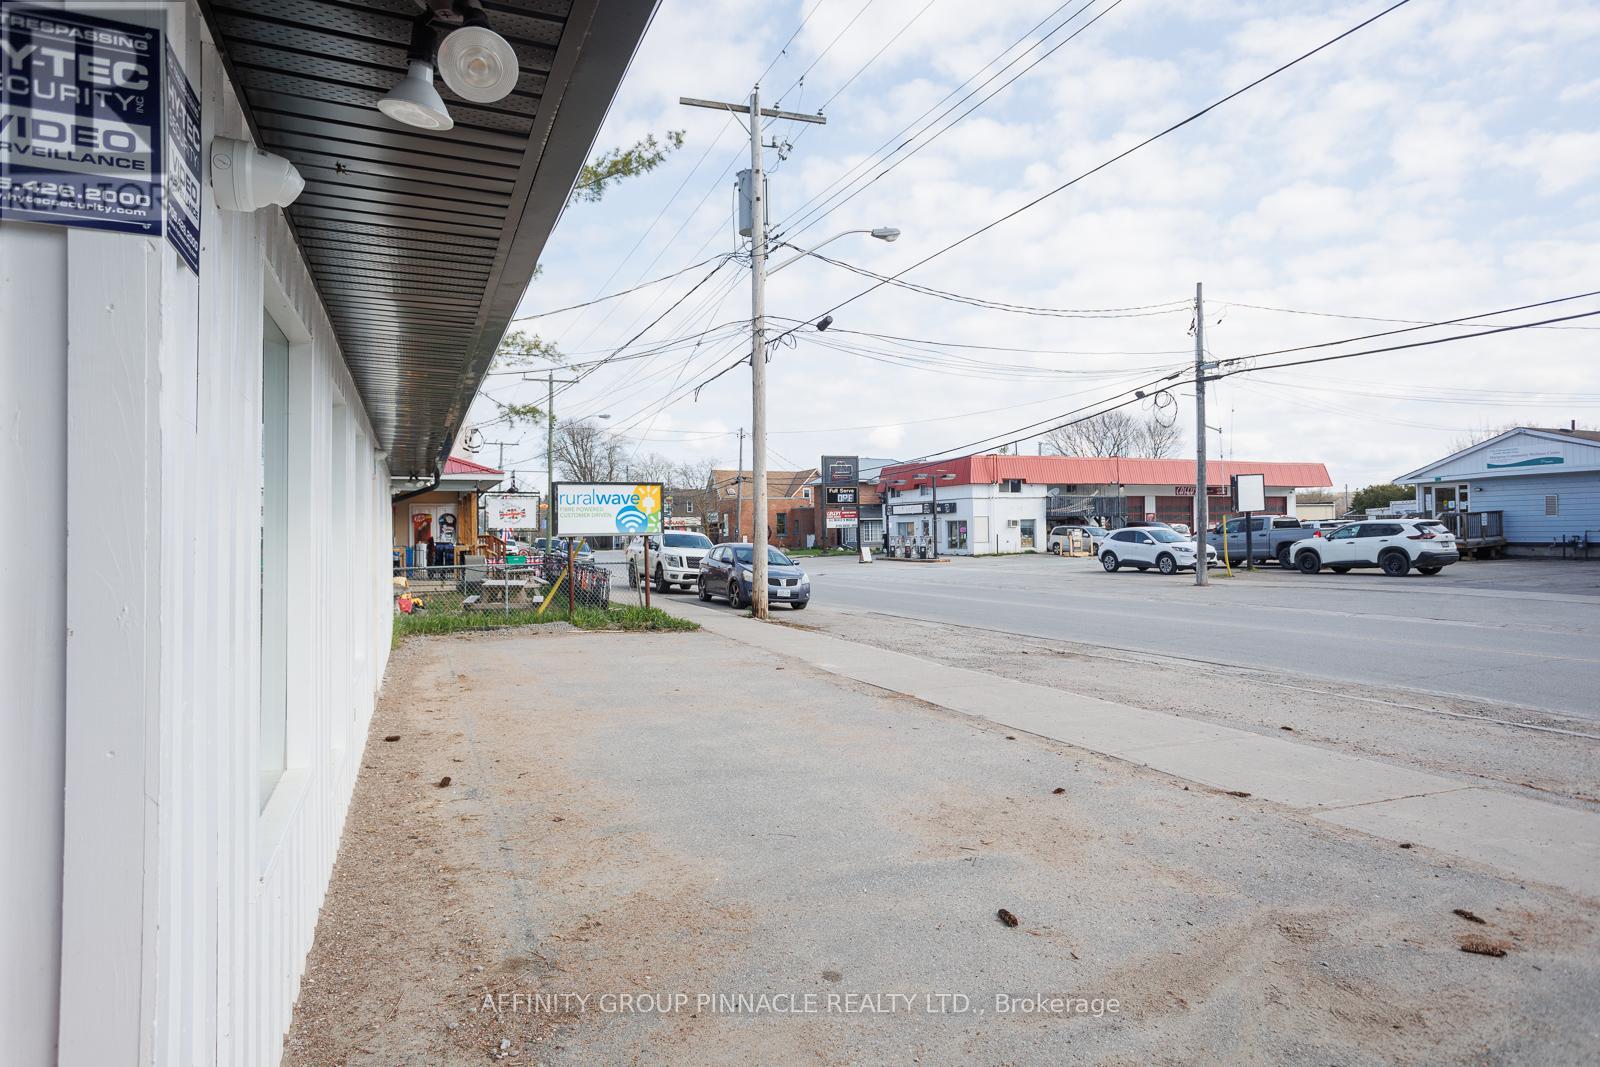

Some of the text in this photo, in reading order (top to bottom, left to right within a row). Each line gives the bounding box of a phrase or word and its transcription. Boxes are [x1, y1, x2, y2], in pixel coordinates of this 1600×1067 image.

[0, 13, 149, 51] TRESPASSING
[0, 73, 136, 111] CURITY
[0, 191, 148, 217] .hytecsecurity.com
[559, 489, 640, 505] ruralwave
